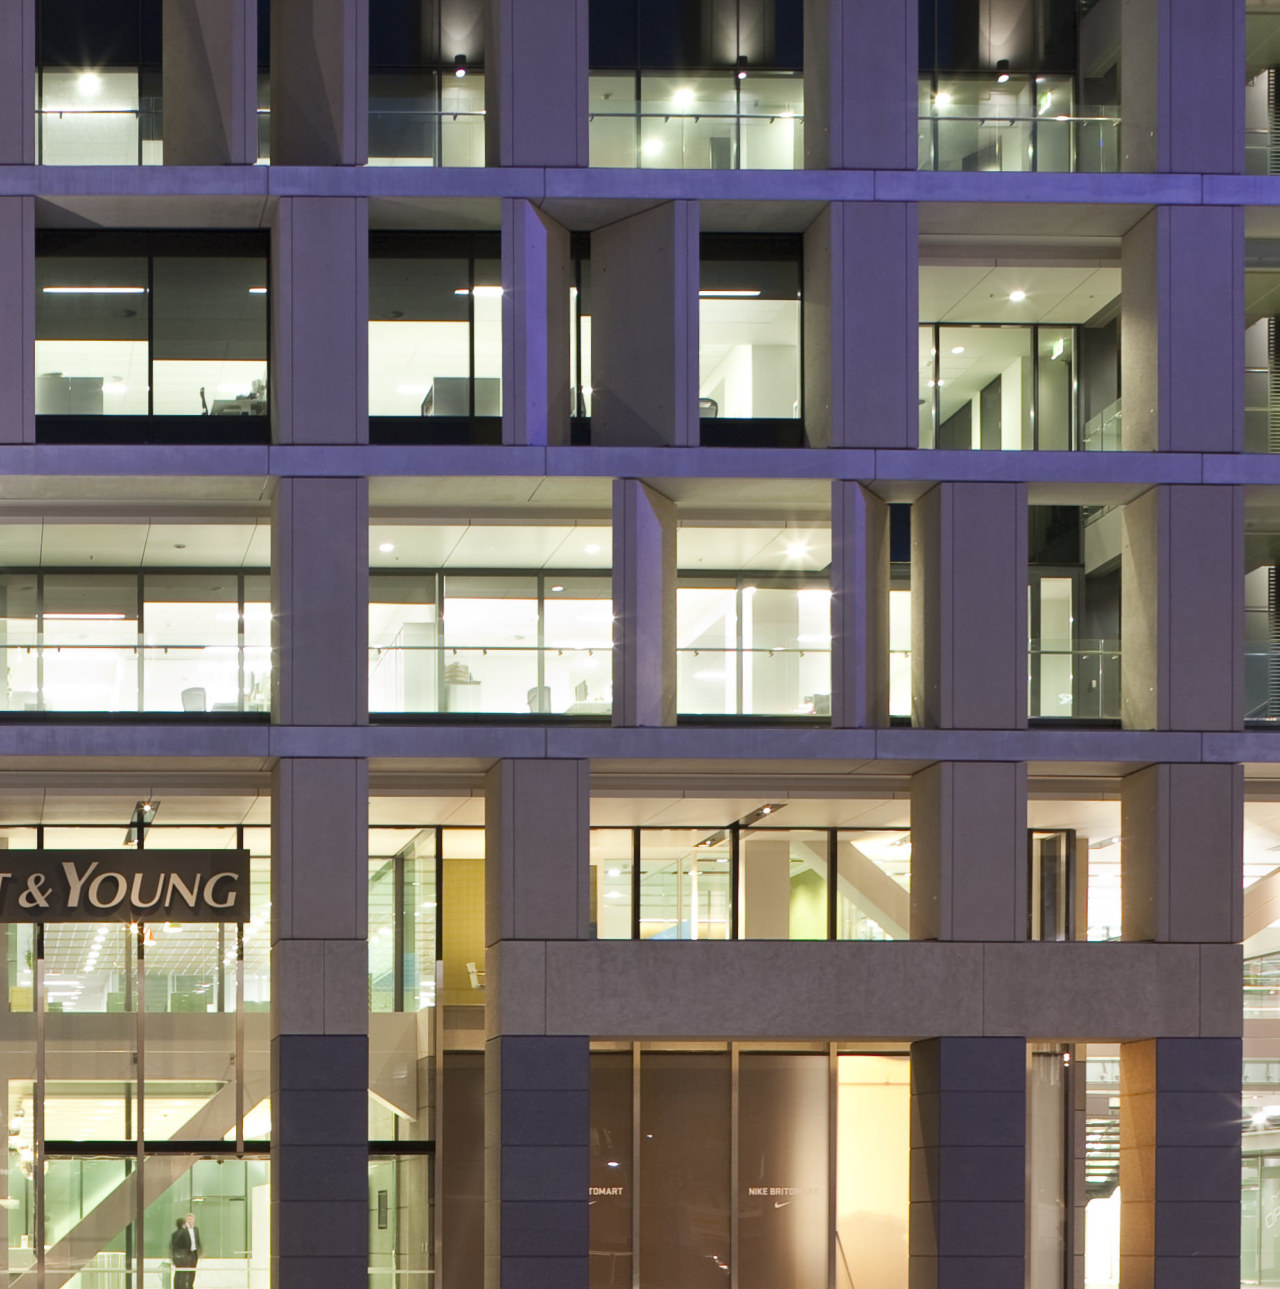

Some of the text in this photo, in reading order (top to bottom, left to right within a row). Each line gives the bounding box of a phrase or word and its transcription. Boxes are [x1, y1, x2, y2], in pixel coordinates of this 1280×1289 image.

[18, 872, 53, 909] &
[62, 861, 239, 909] YOUNG
[748, 1187, 768, 1196] NIKE
